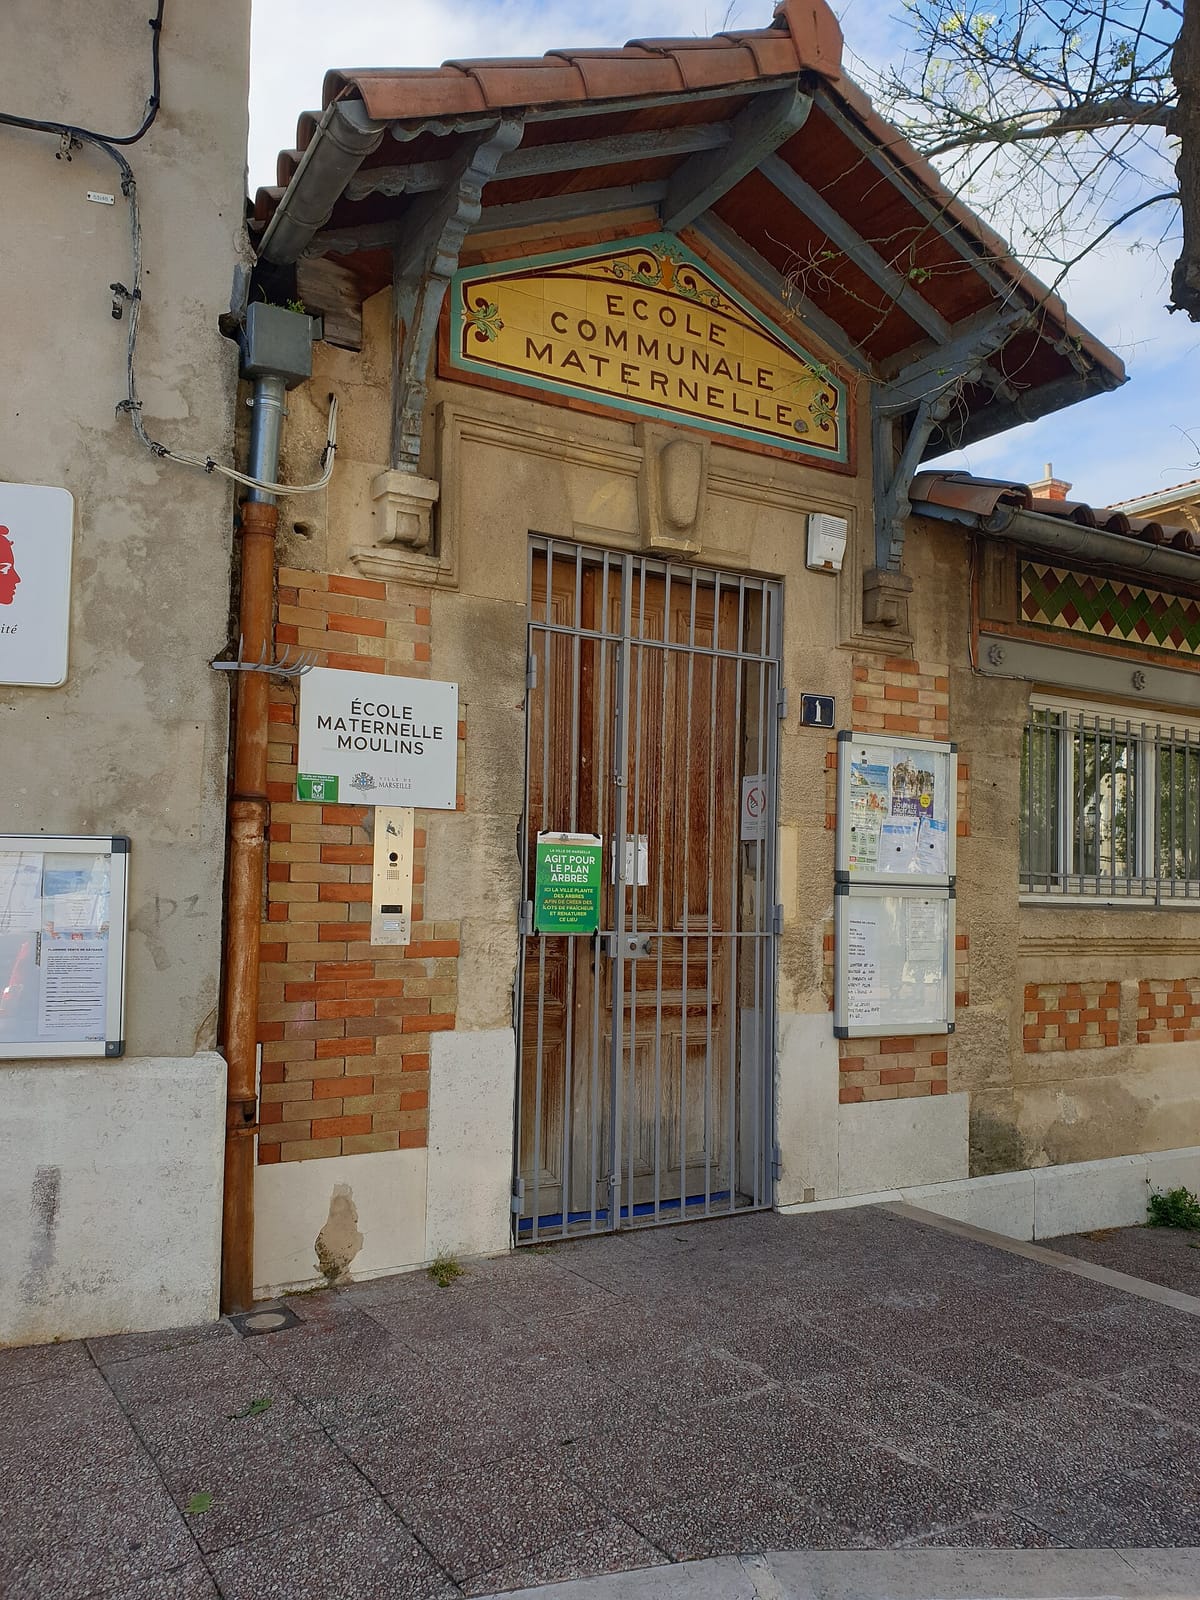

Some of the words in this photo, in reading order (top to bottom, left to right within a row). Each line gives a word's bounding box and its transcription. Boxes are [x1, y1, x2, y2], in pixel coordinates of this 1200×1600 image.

[606, 294, 727, 347] ECOLE
[550, 311, 774, 391] COMMUNALE
[525, 337, 792, 427] MATERNELLE
[351, 698, 413, 720] ÉCOLE
[814, 699, 822, 722] 1
[317, 715, 443, 740] MATERNELLE
[337, 735, 424, 755] MOULINS
[379, 782, 412, 790] MARSEILLE
[544, 854, 568, 863] AGIT
[569, 855, 596, 865] POUR
[550, 864, 562, 873] LE
[564, 864, 589, 874] PLAN
[550, 873, 589, 883] ARBRES
